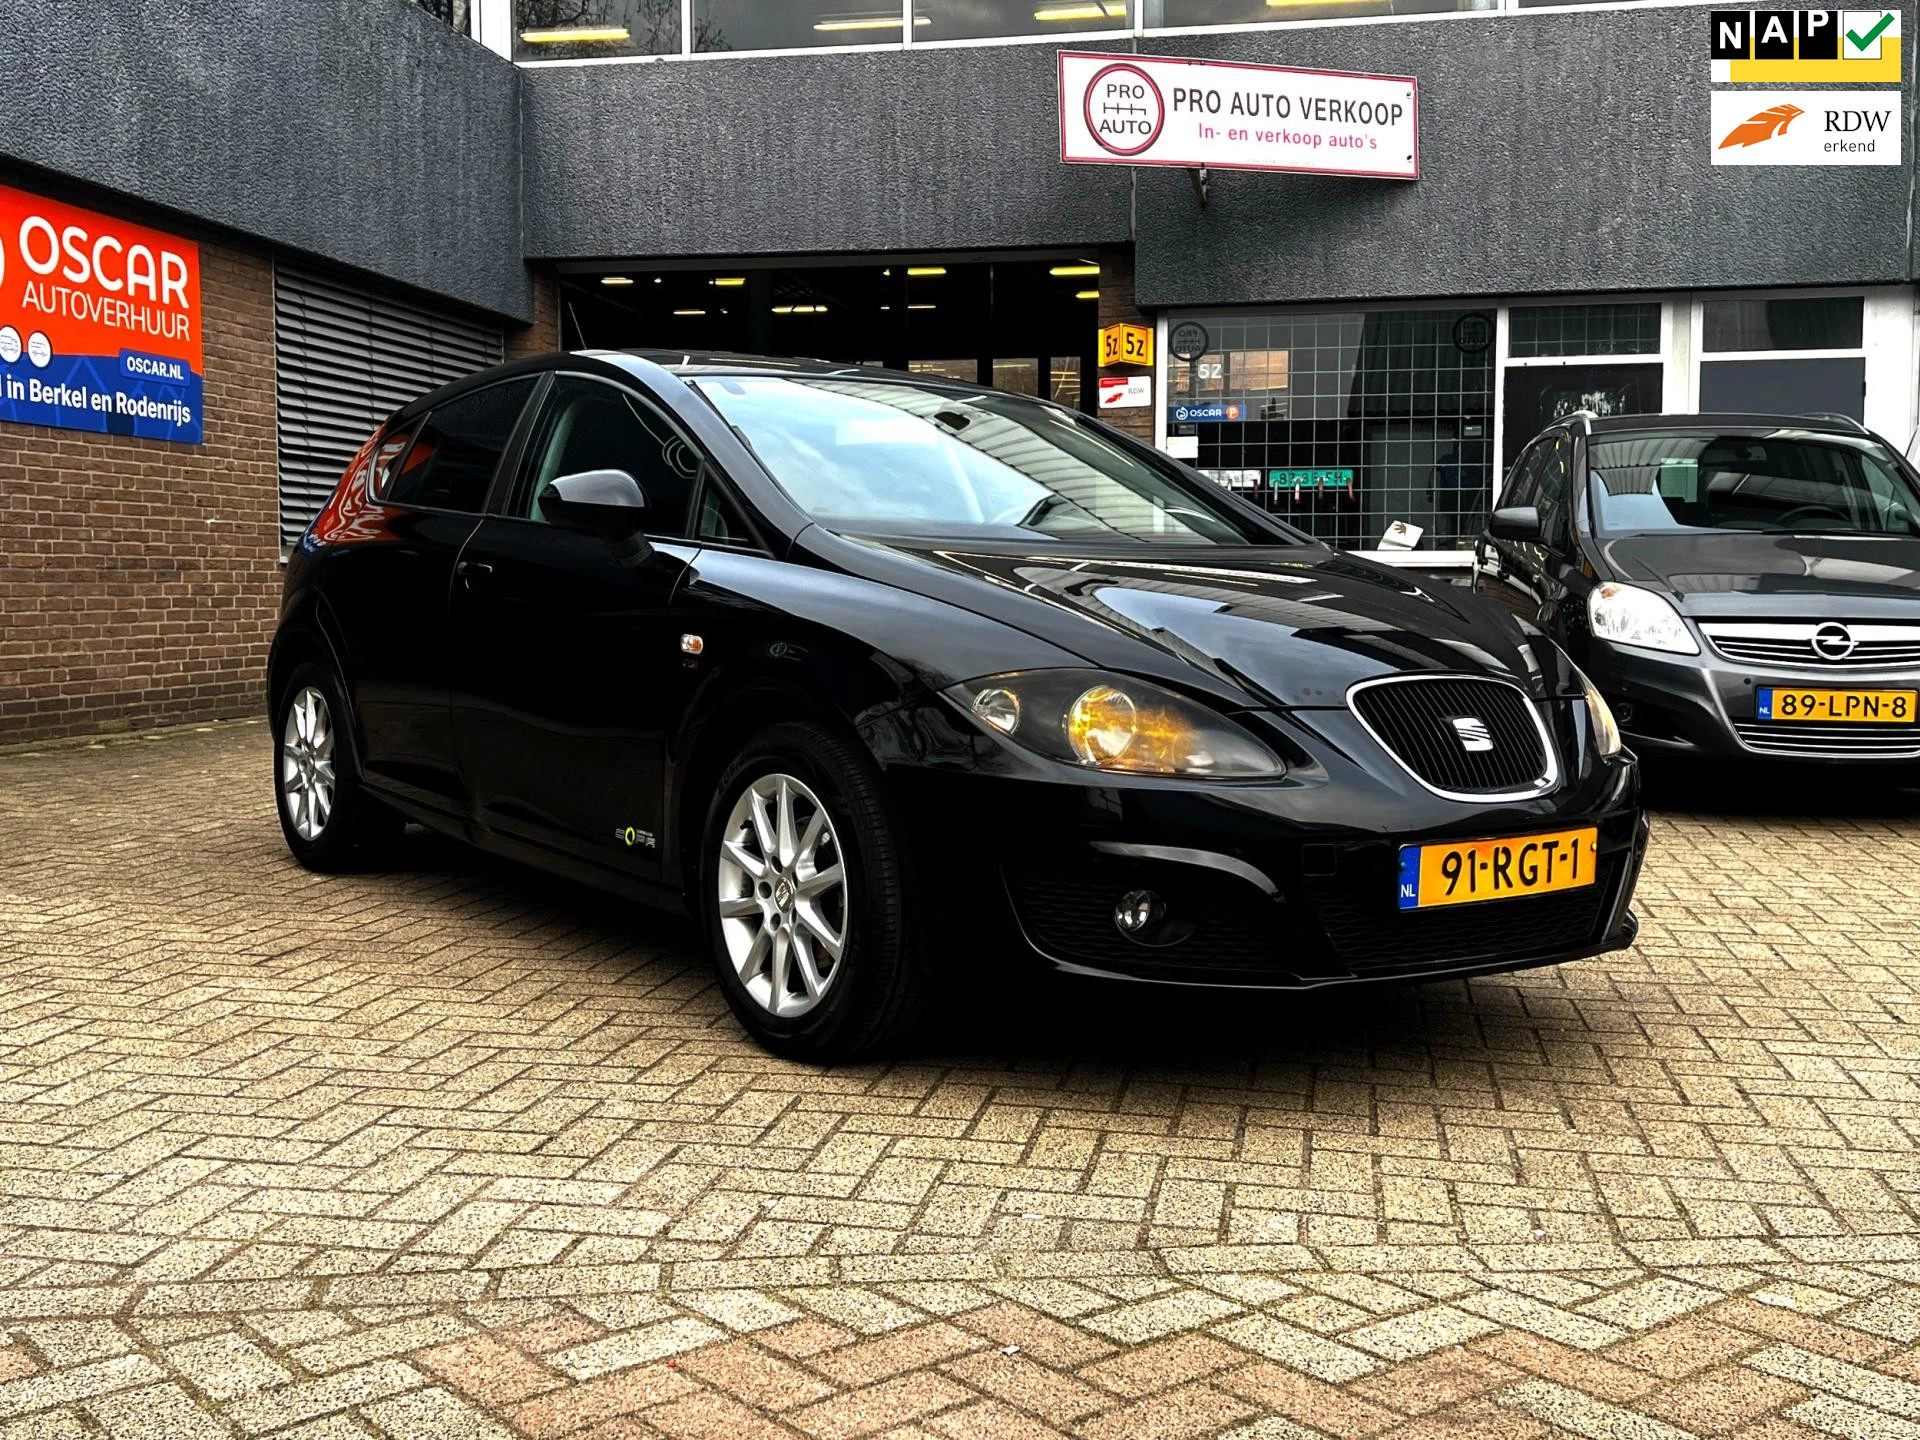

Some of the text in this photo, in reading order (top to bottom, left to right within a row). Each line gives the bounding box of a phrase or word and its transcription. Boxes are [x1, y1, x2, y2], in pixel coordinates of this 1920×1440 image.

[1106, 83, 1145, 100] PRO
[1172, 87, 1403, 127] PRO AUTO VERKOOP
[1098, 119, 1152, 135] AUTO
[1199, 122, 1378, 150] In- en verkoop auto's
[19, 215, 190, 309] OSCAR
[22, 280, 191, 342] AUTOVERHUUR
[126, 355, 184, 381] OSCAR.NL
[6, 373, 25, 400] in
[29, 378, 87, 409] Berkel
[91, 394, 112, 413] en
[116, 392, 191, 427] Rodenrijs
[1189, 408, 1222, 417] OSCAR
[1759, 694, 1907, 718] NL 89-LPN-8
[1400, 838, 1579, 898] NL 91-RGT-1
